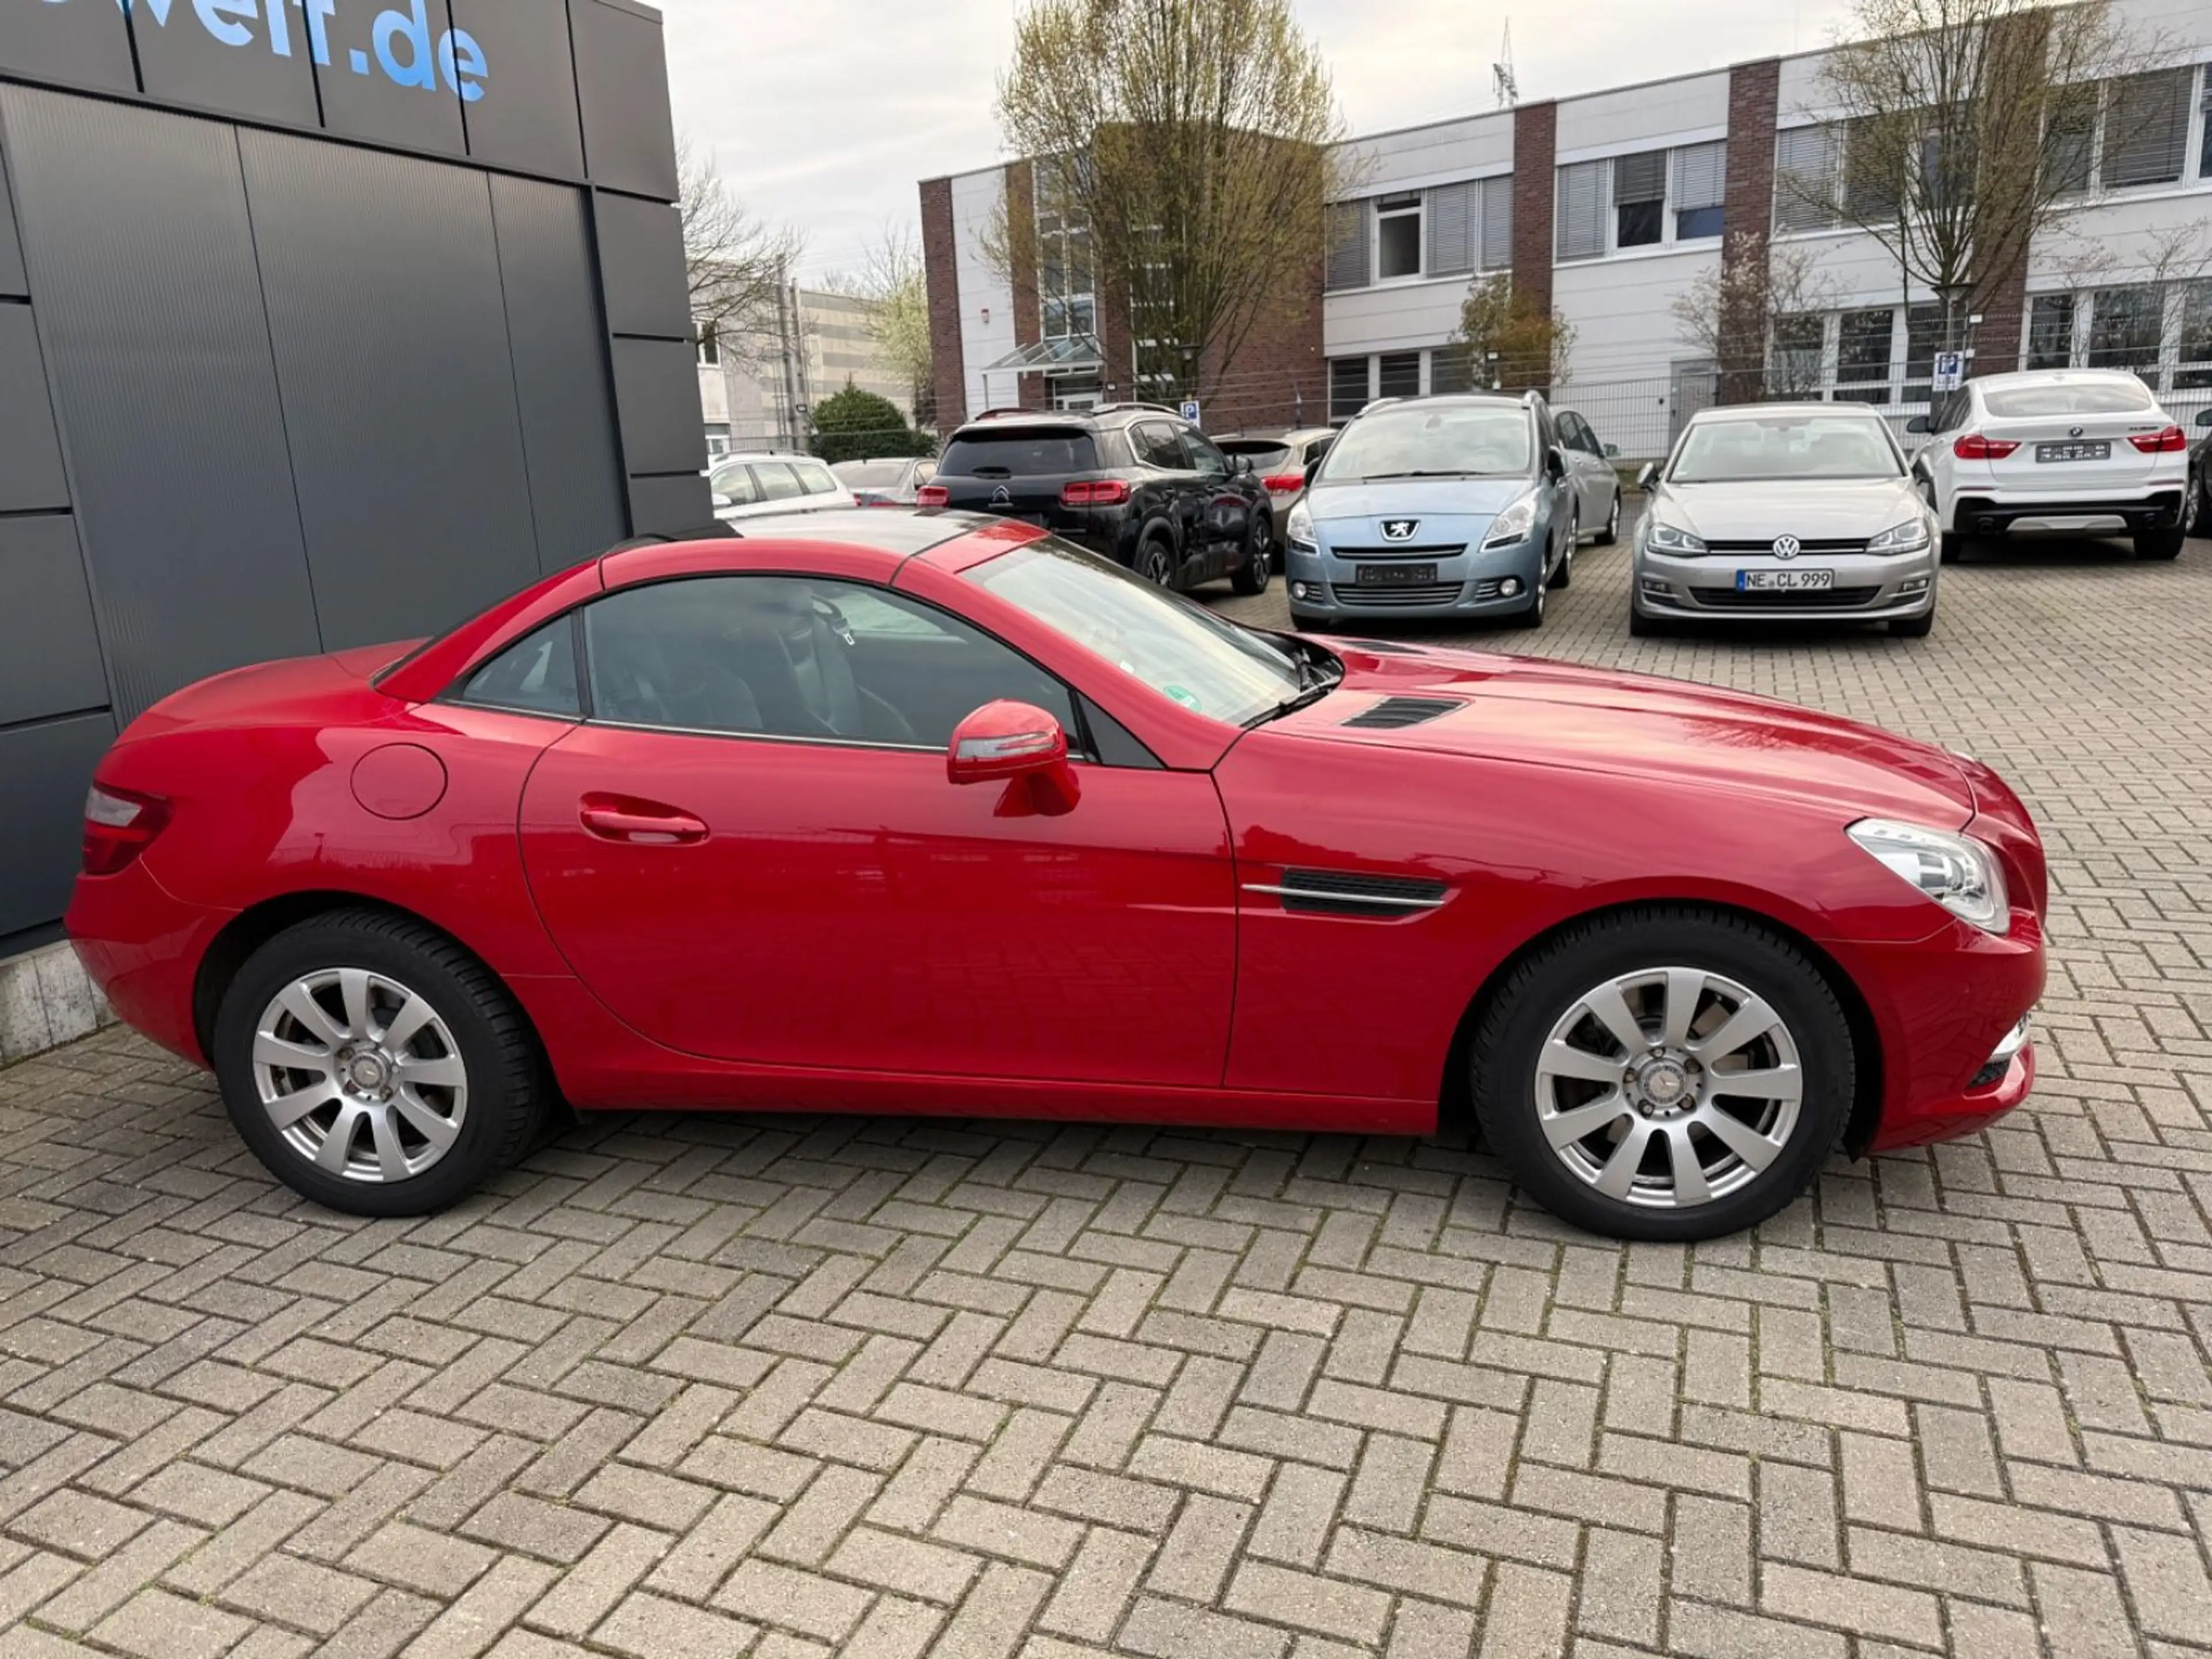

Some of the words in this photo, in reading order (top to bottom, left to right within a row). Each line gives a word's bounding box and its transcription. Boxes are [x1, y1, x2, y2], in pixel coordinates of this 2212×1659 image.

[1185, 405, 1195, 418] P
[1747, 574, 1766, 587] NE
[1777, 573, 1798, 587] CL
[1801, 572, 1830, 586] 999
